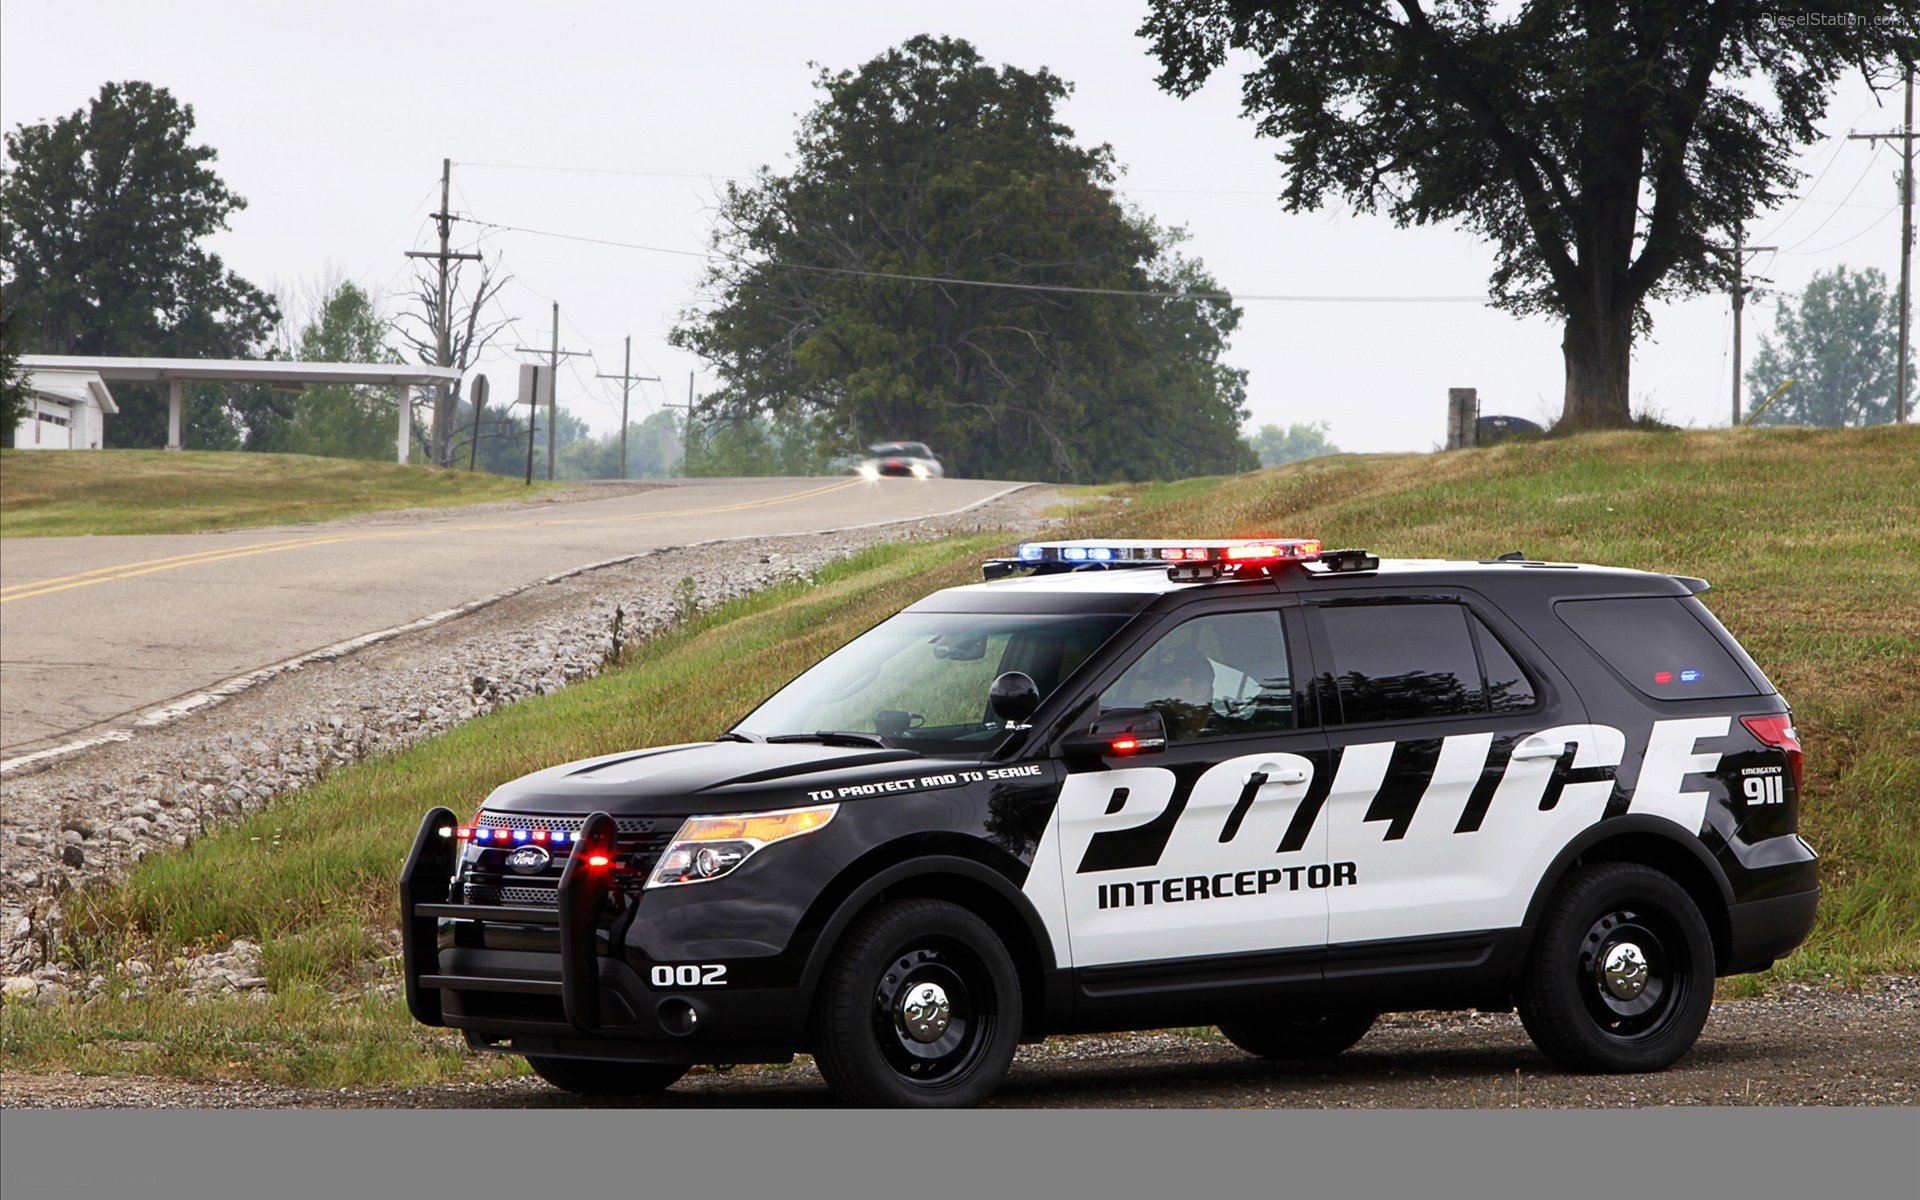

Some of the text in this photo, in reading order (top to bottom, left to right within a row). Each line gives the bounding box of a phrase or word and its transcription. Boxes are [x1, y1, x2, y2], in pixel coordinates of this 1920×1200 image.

[808, 765, 1042, 801] TO PROTECT AND TO SERVE
[1741, 766, 1782, 775] EMERGENCY
[1022, 716, 1731, 892] POLICE
[1743, 775, 1784, 806] 911
[513, 850, 538, 866] Ford
[1098, 861, 1357, 909] INTERCEPTOR
[651, 964, 728, 986] 002
